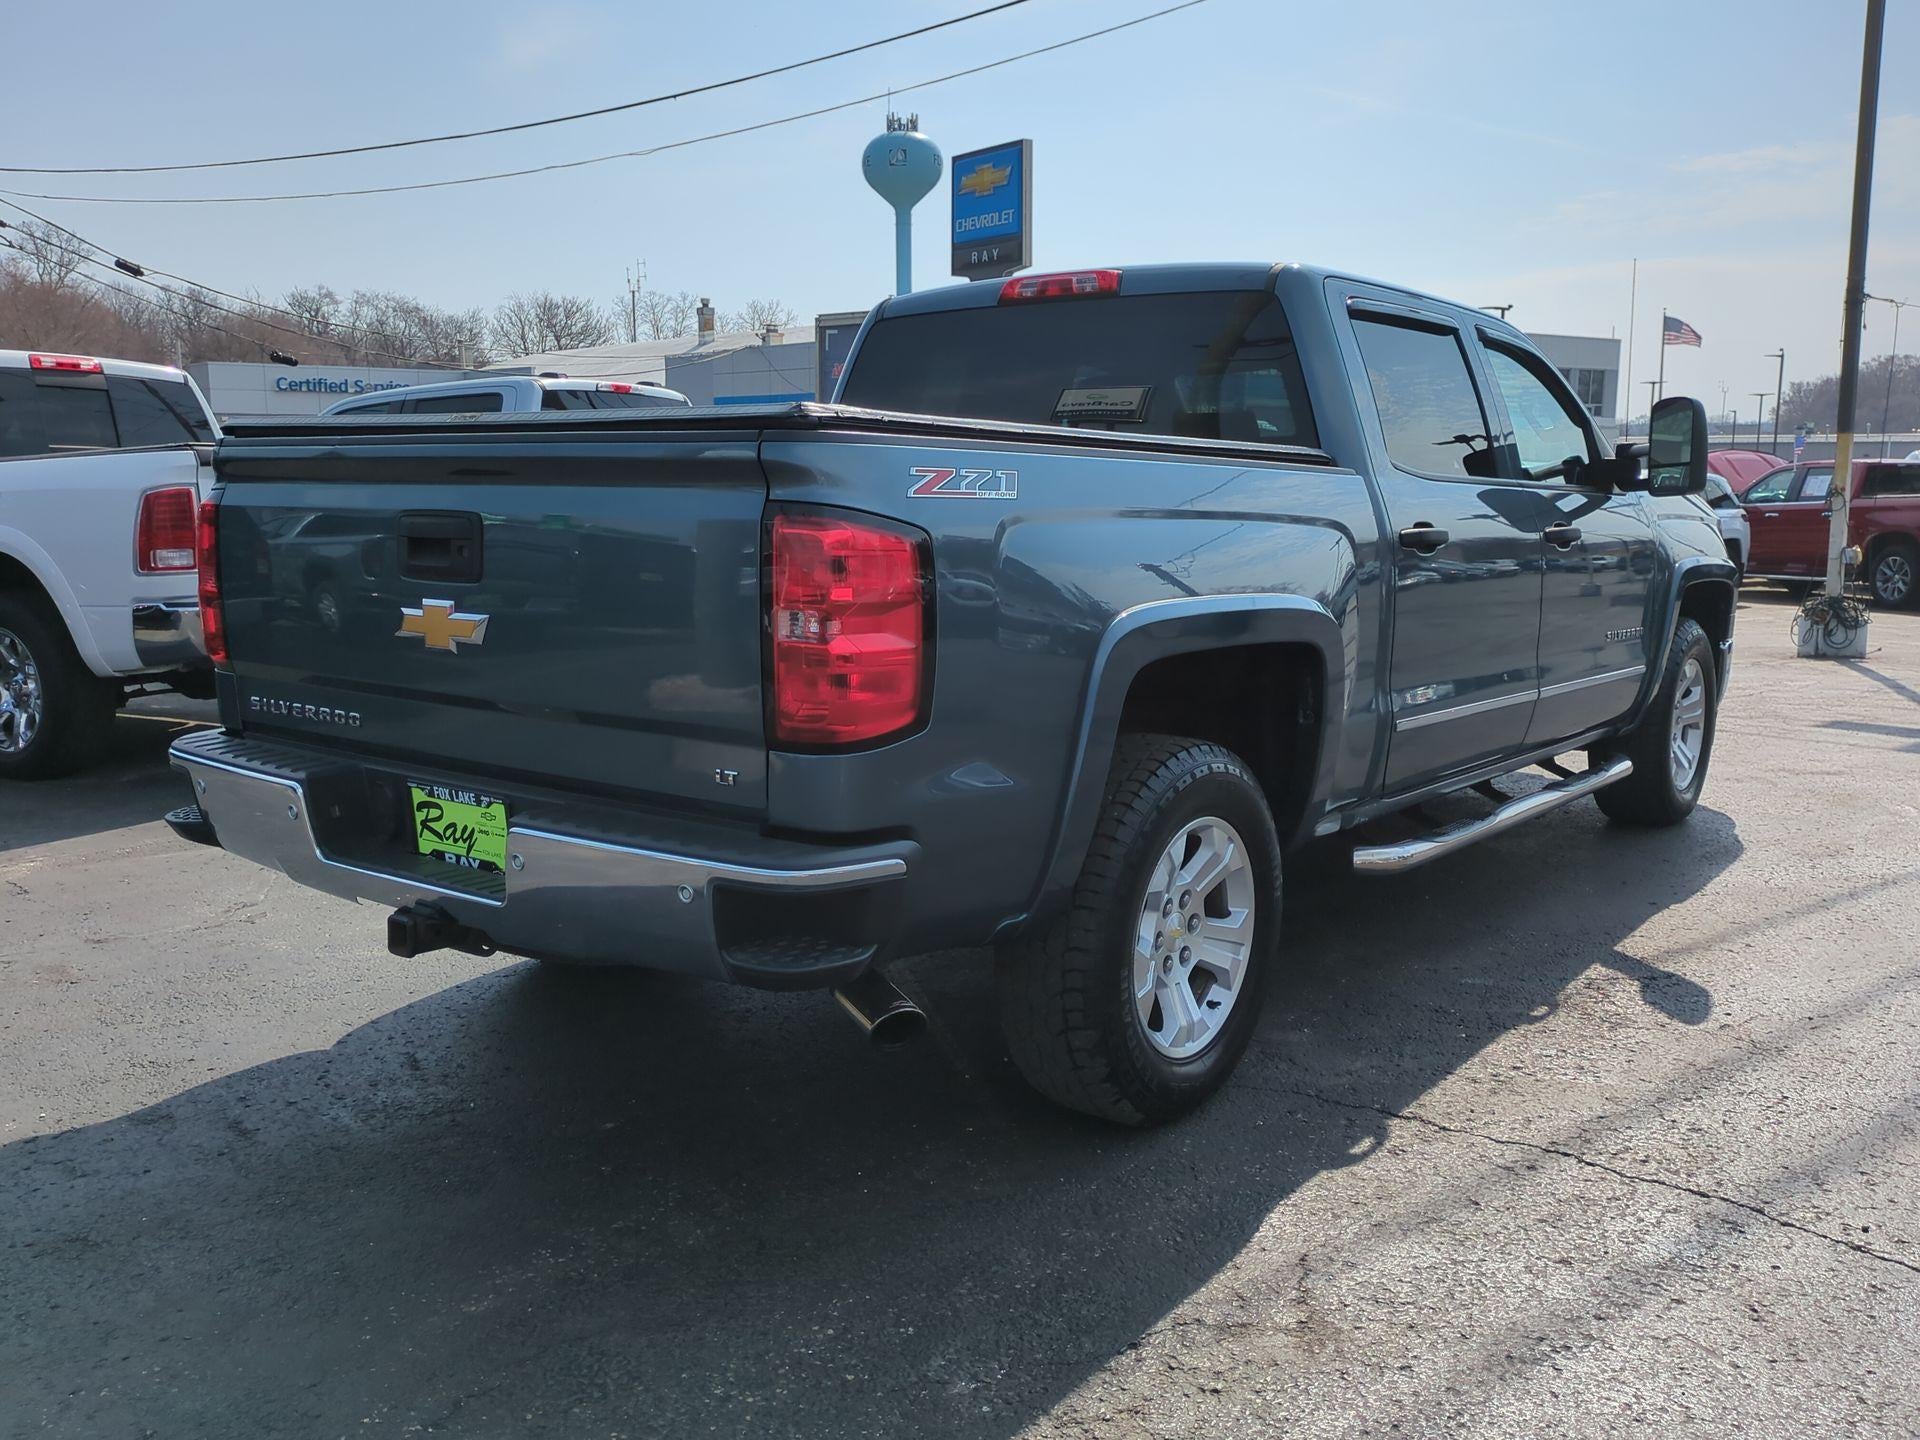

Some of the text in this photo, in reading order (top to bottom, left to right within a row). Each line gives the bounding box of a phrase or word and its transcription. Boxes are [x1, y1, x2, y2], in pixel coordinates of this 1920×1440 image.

[955, 208, 1015, 233] CHEVROLET
[971, 248, 999, 264] RAY
[275, 376, 348, 393] Certified
[906, 466, 1018, 499] Z71
[250, 696, 360, 727] SILVERADO
[715, 769, 738, 786] LT
[433, 786, 451, 801] FOX
[452, 789, 477, 806] LAKE
[416, 800, 478, 857] Ray
